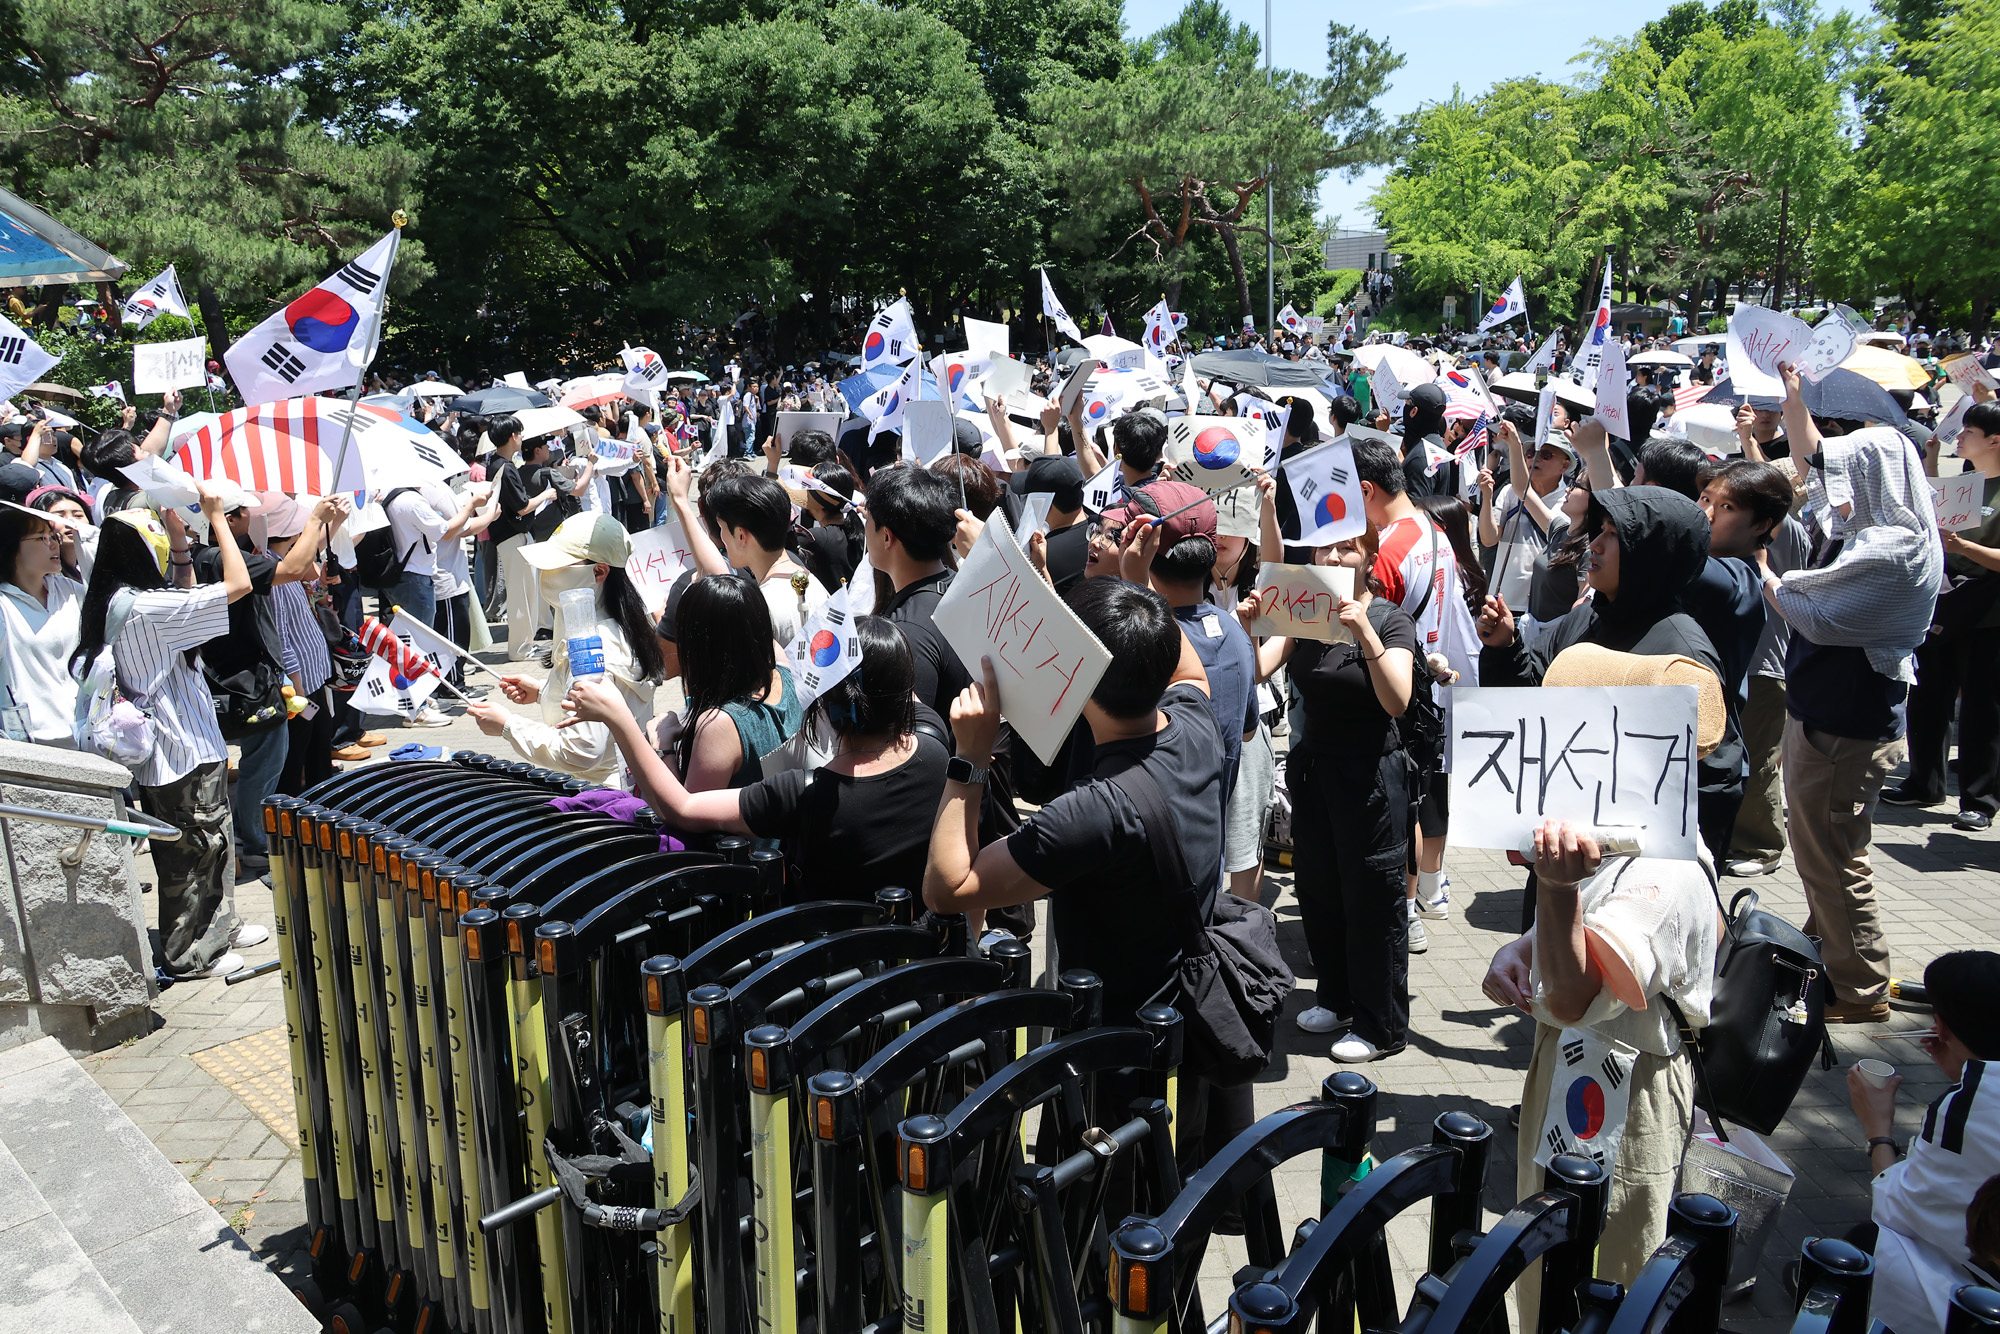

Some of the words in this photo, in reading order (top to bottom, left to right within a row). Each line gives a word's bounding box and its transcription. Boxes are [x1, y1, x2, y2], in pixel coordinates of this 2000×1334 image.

[141, 345, 204, 379] 재선거
[1740, 328, 1791, 372] 재선거
[969, 537, 1083, 716] 재선거
[1261, 586, 1342, 624] 재선거
[1462, 705, 1692, 837] 재선거
